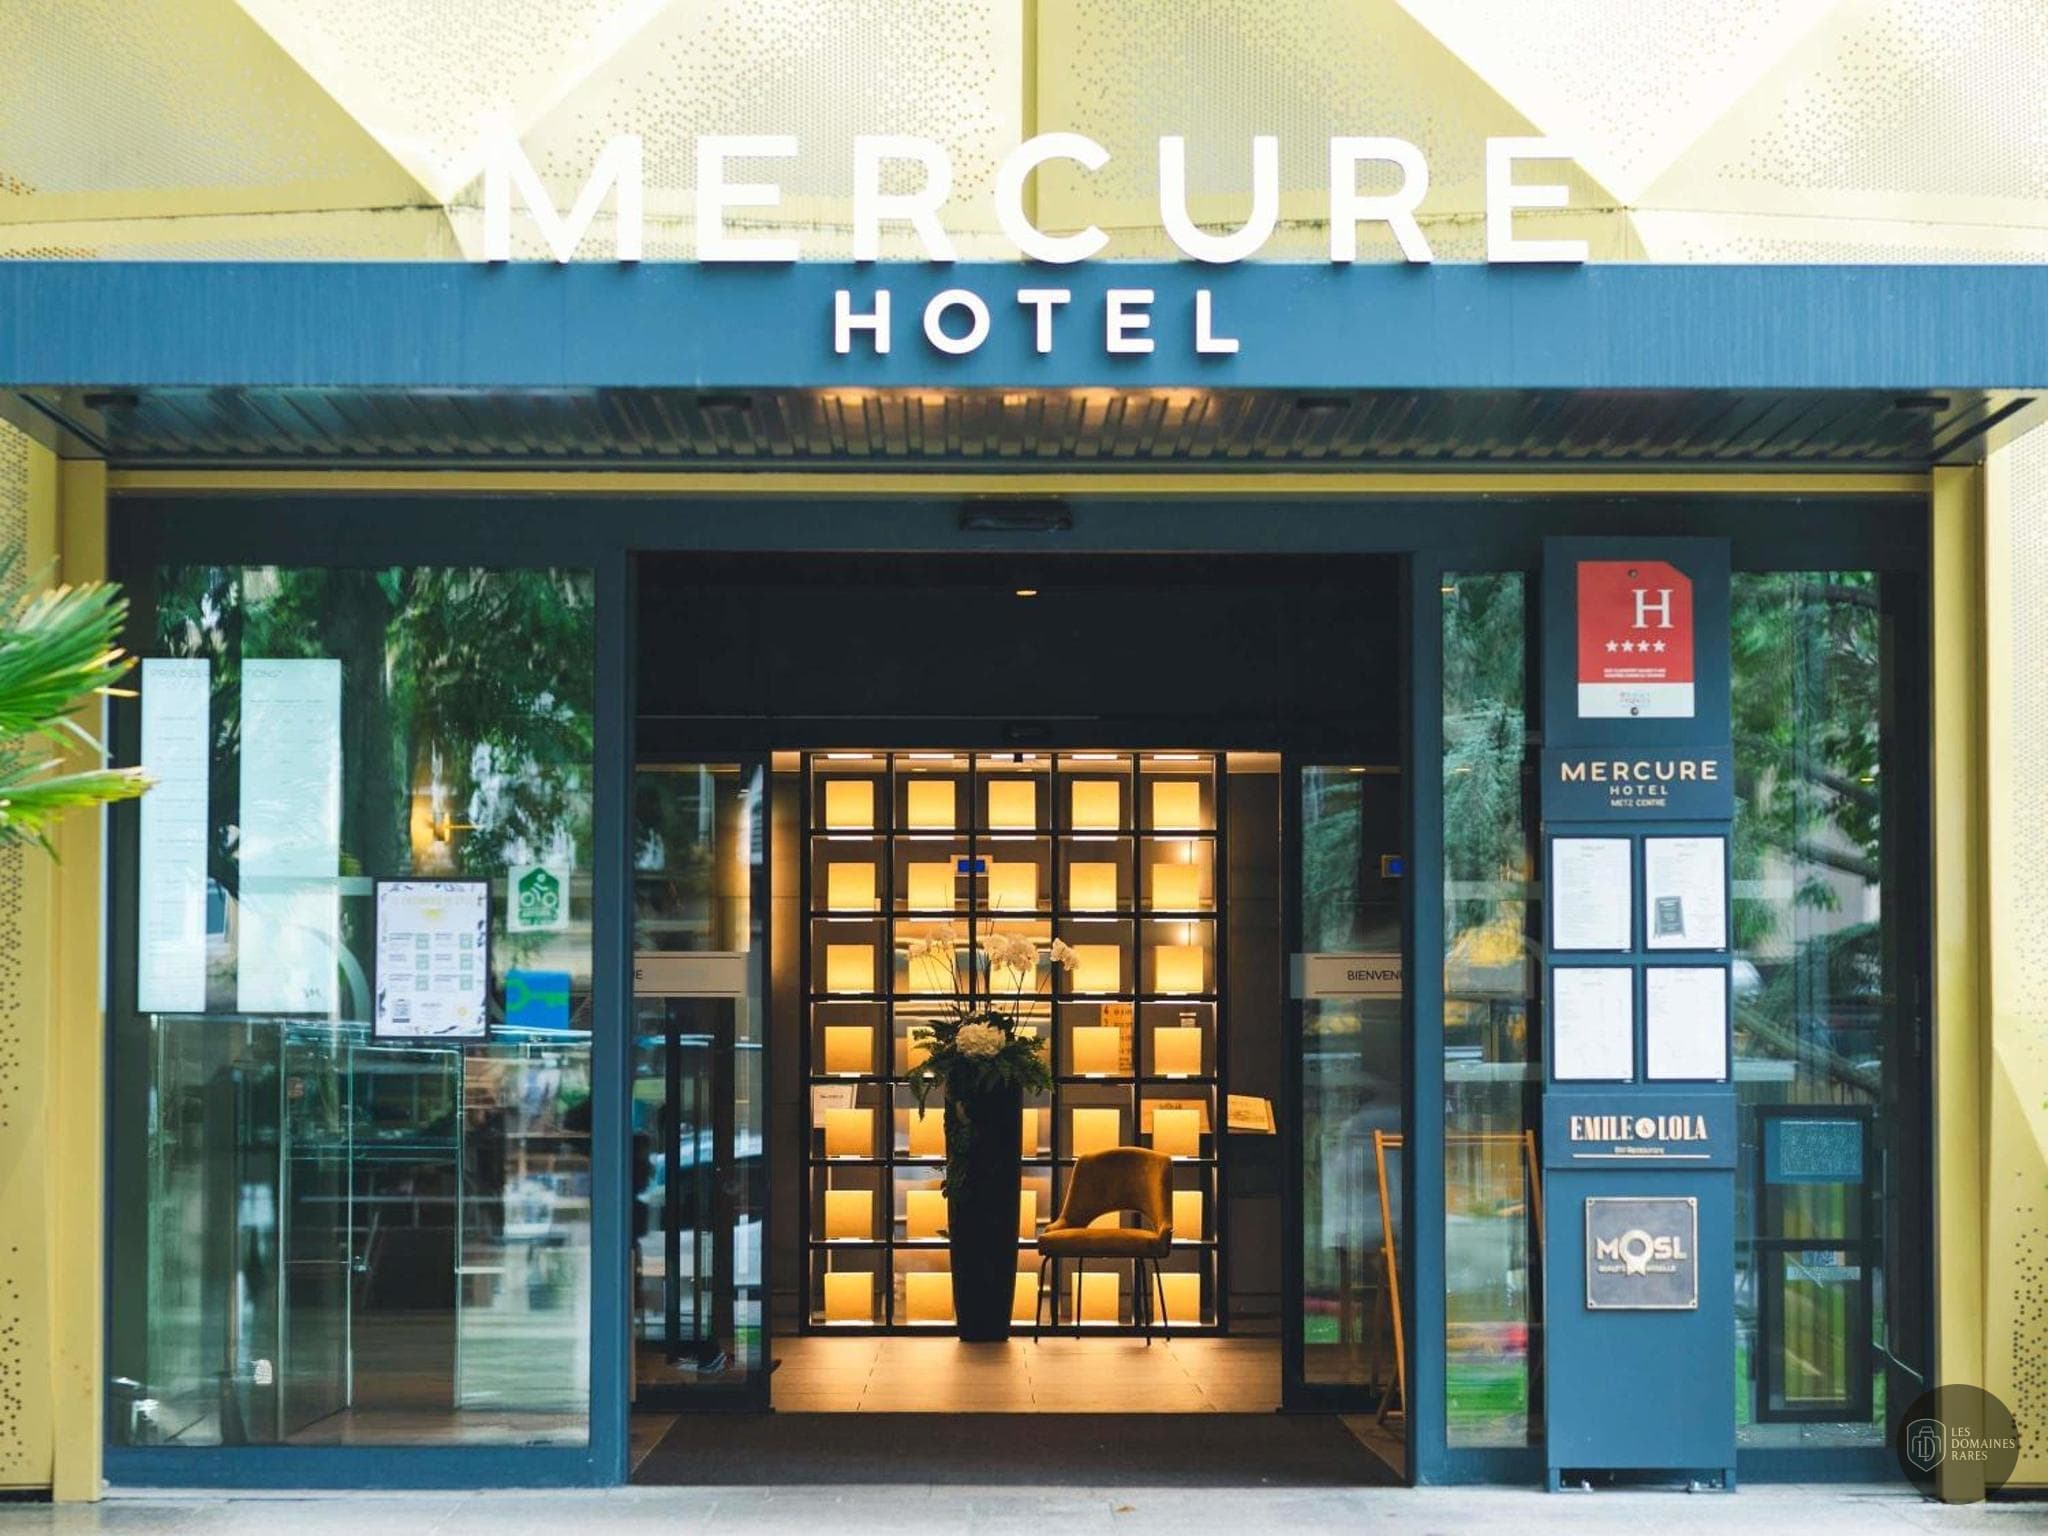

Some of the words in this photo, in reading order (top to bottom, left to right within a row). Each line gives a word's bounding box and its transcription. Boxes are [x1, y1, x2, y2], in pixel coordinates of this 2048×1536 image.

[484, 132, 1589, 264] MERCURE
[832, 288, 1240, 355] HOTEL
[1631, 588, 1675, 629] H
[1560, 760, 1719, 782] MERCURE
[1609, 784, 1669, 796] HOTEL
[1610, 799, 1634, 807] METZ
[1635, 799, 1667, 807] CENTRE
[1346, 969, 1403, 981] BIENVEN
[1570, 1115, 1634, 1141] EMILE
[1658, 1115, 1708, 1141] LOLA
[1596, 1229, 1688, 1262] MOSL
